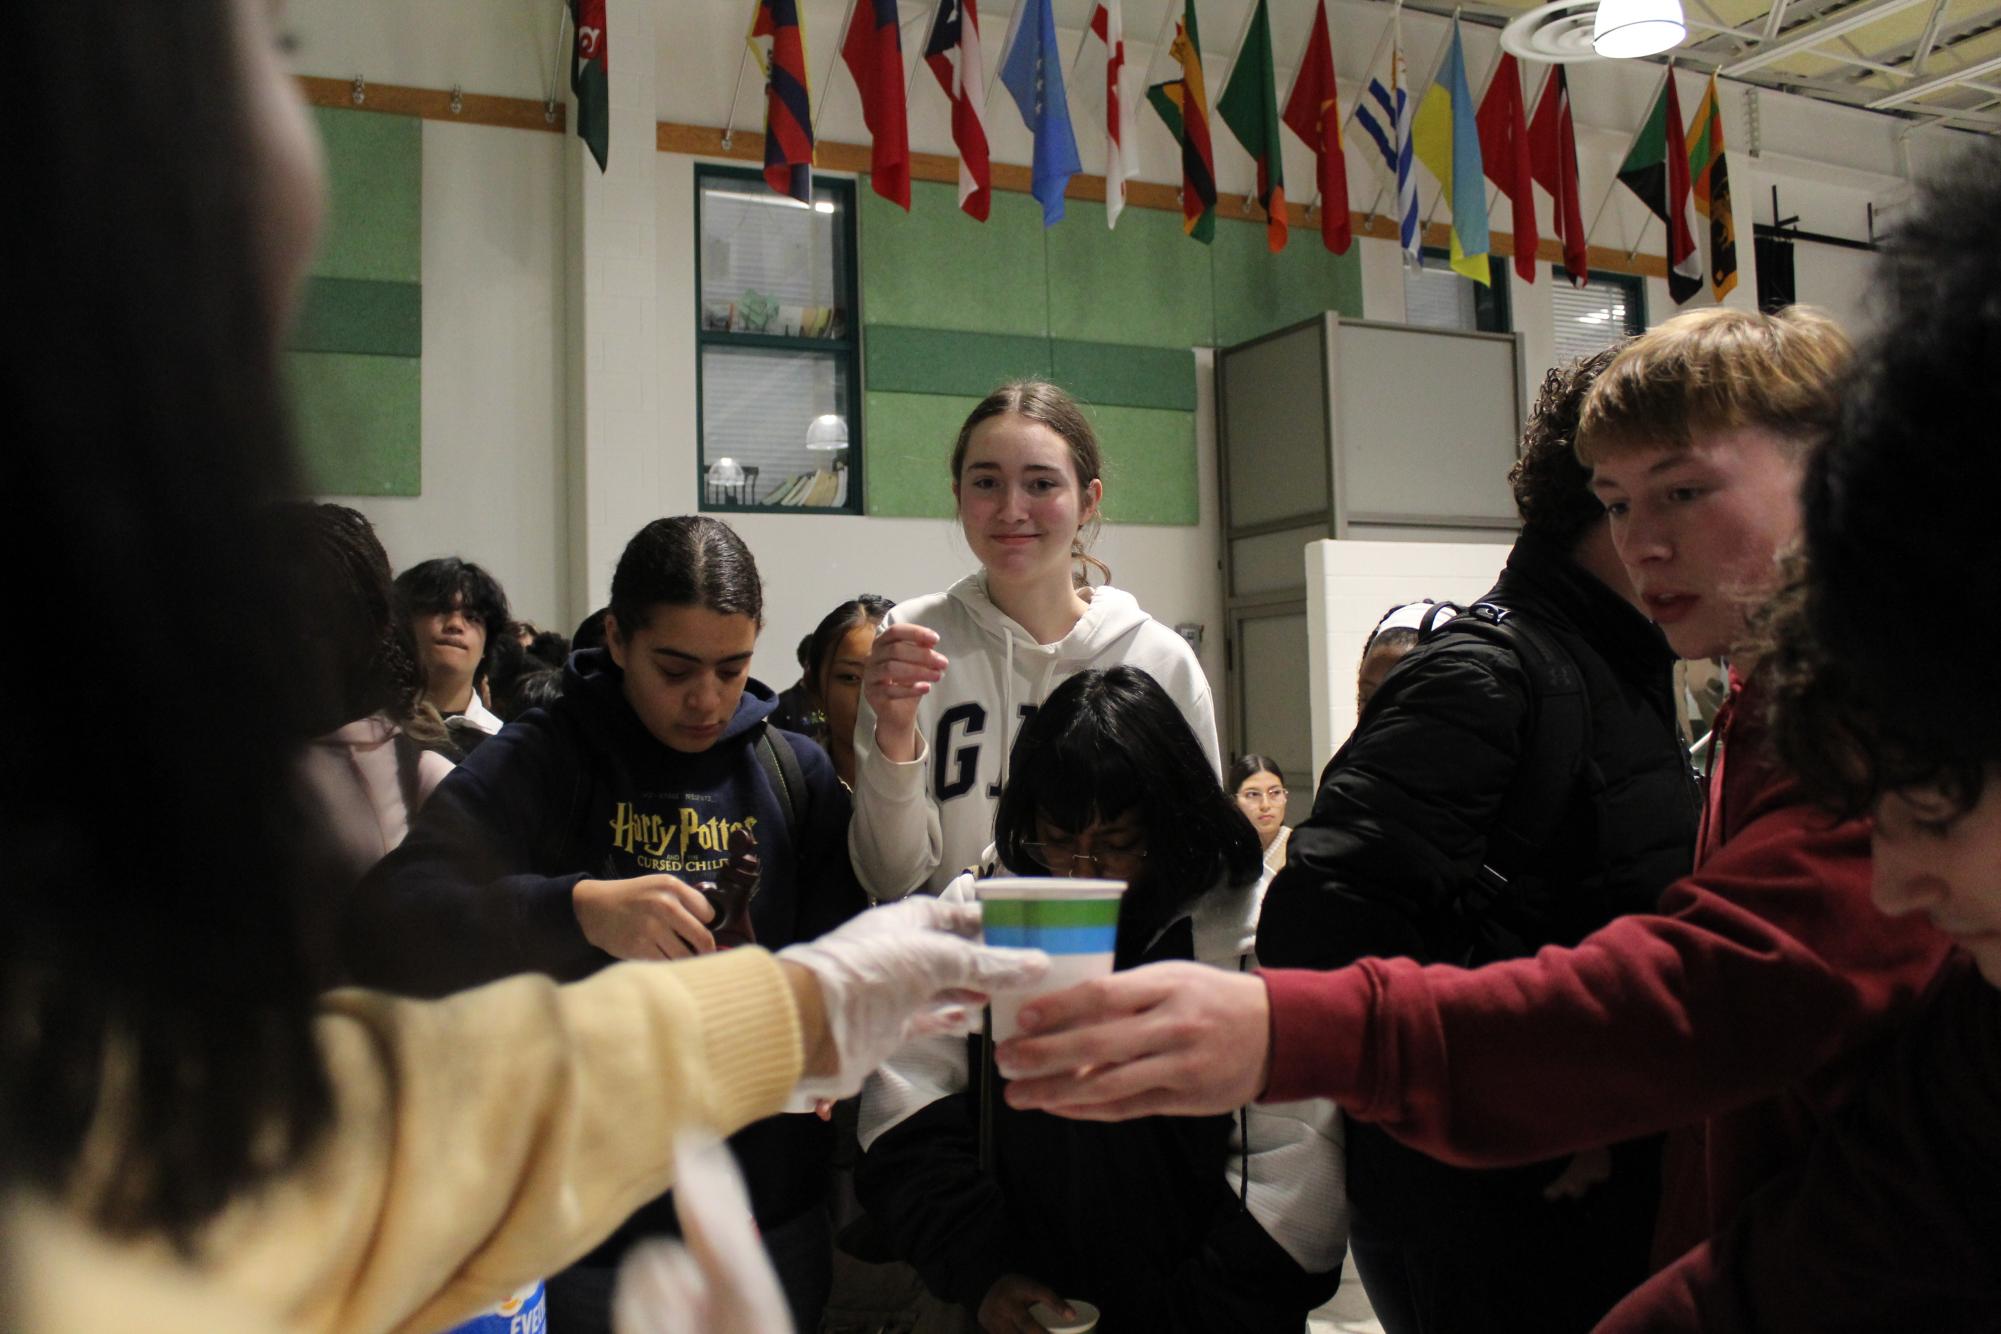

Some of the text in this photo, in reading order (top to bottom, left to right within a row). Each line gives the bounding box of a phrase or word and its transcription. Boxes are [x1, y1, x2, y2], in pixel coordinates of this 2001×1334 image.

[609, 802, 758, 867] Harry Pottr
[637, 855, 681, 872] CURSED
